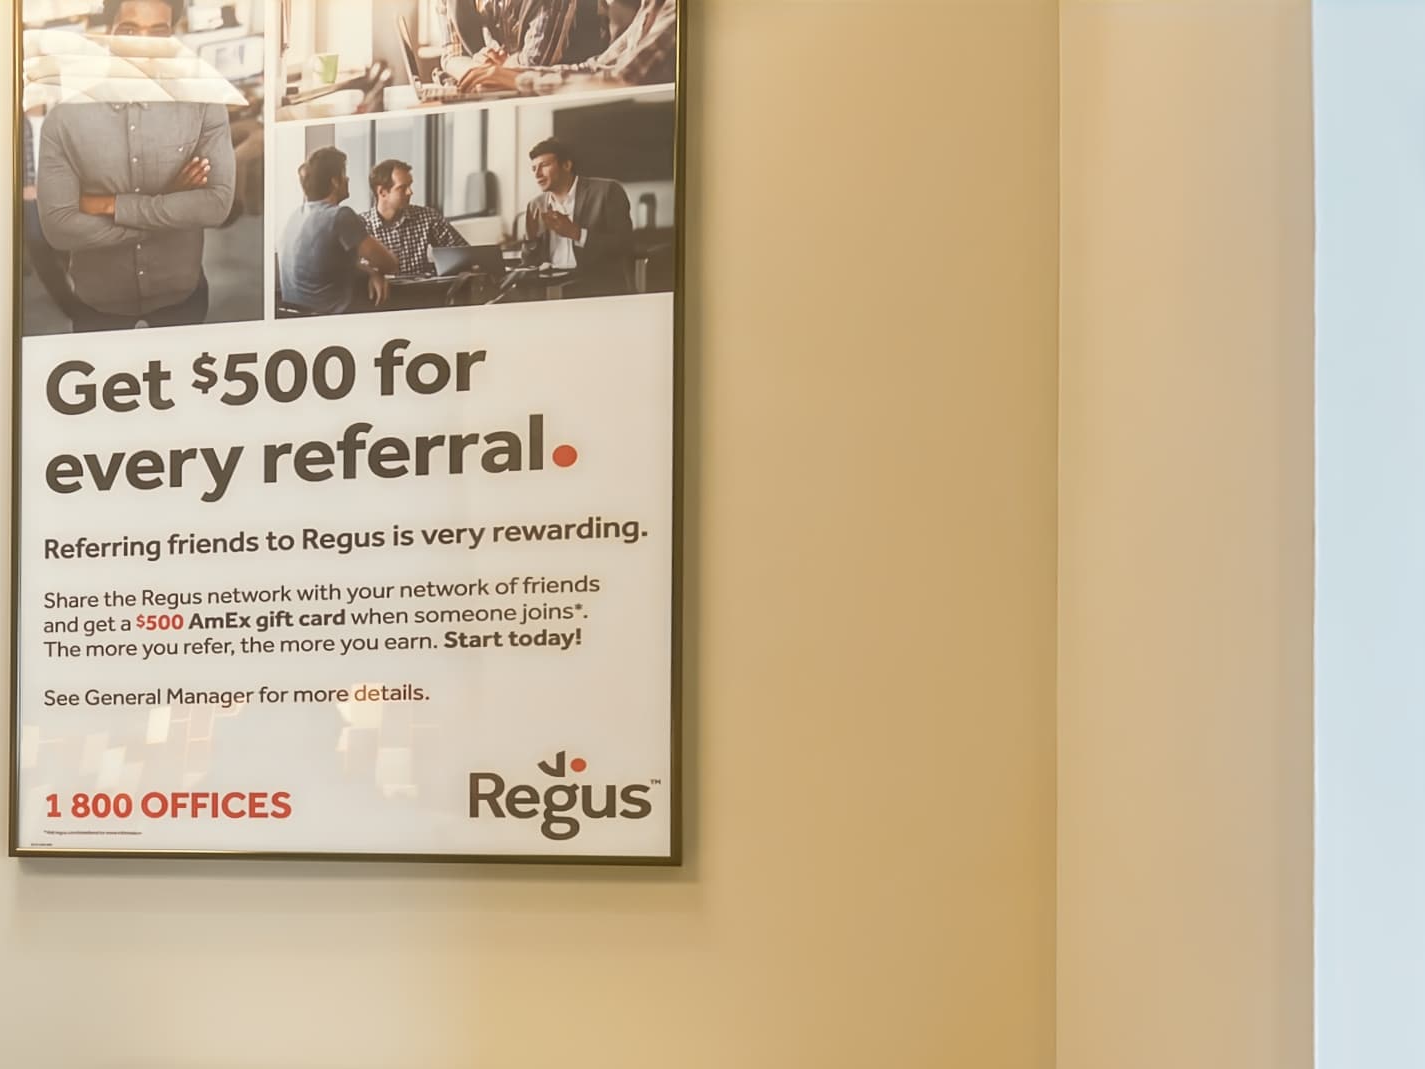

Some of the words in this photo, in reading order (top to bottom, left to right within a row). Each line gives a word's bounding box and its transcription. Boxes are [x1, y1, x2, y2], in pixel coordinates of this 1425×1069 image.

[46, 359, 175, 416] Get
[191, 345, 356, 408] $500
[374, 338, 487, 397] for
[45, 444, 244, 503] every
[263, 413, 578, 485] referral.
[44, 534, 161, 562] Referring
[167, 530, 260, 556] friends
[265, 531, 295, 552] to
[302, 528, 386, 555] Regus
[393, 524, 415, 547] is
[421, 525, 486, 550] very
[493, 516, 649, 545] rewarding.
[43, 589, 98, 609] Share
[102, 588, 137, 608] the
[141, 588, 203, 607] Regus
[207, 585, 293, 604] network
[297, 583, 342, 602] with
[346, 584, 396, 605] your
[400, 578, 490, 600] network
[494, 576, 518, 596] of
[522, 573, 601, 596] friends
[43, 615, 79, 634] and
[83, 615, 117, 637] get
[121, 618, 132, 633] a
[136, 611, 184, 632] $500
[188, 610, 252, 631] AmEx
[255, 609, 295, 632] gift
[299, 606, 347, 628] card
[350, 605, 410, 625] when
[414, 605, 517, 624] someone
[43, 639, 81, 659] The
[85, 643, 138, 659] more
[141, 642, 179, 660] you
[183, 636, 236, 658] refer,
[240, 635, 276, 655] the
[280, 637, 336, 655] more
[339, 637, 379, 657] you
[383, 634, 439, 651] earn.
[443, 629, 504, 650] Start
[508, 626, 583, 652] today!
[43, 688, 80, 707] See
[84, 686, 162, 707] General
[166, 685, 254, 709] Manager
[257, 684, 290, 704] for
[293, 687, 350, 704] more
[354, 682, 431, 704] details.
[45, 794, 62, 818] 1
[70, 793, 133, 819] 800
[140, 791, 293, 820] OFFICES
[469, 772, 653, 841] Regus
